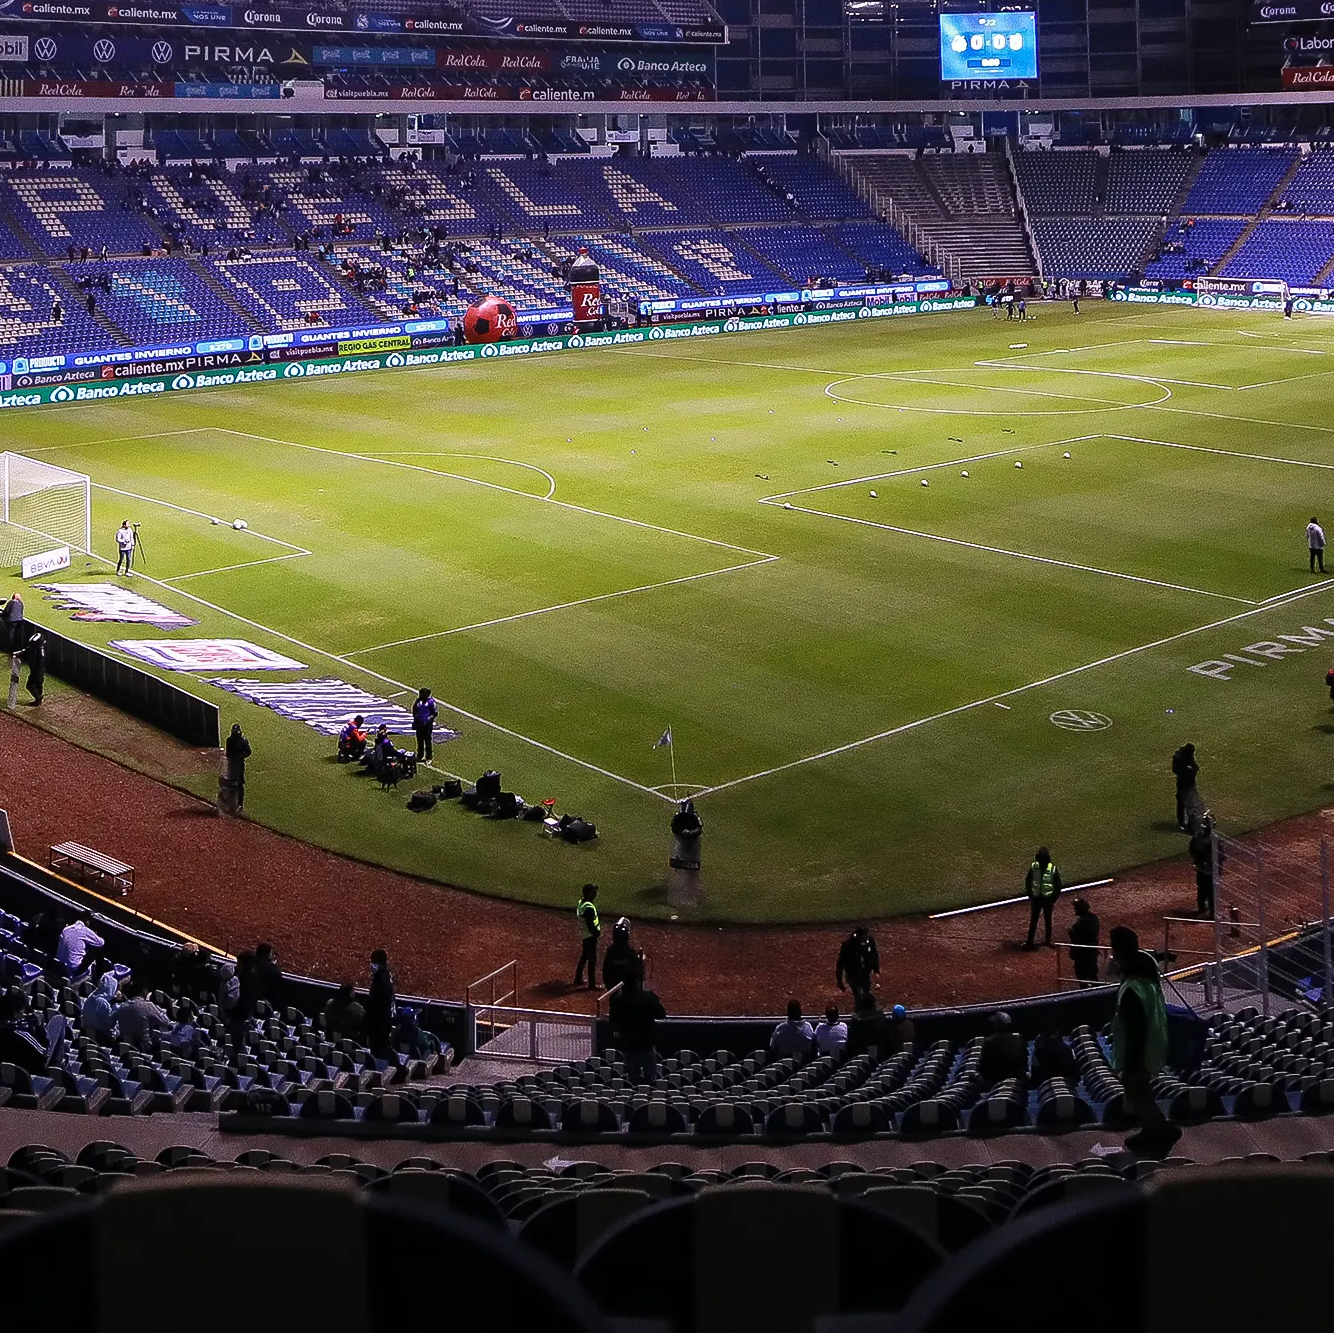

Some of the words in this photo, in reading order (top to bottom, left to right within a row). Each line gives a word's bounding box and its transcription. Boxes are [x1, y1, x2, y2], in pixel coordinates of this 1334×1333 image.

[33, 3, 90, 15] caliente.mx
[119, 8, 177, 20] caliente.mx
[1261, 6, 1296, 18] Corona
[245, 10, 281, 24] Corona
[307, 12, 343, 26] Corona
[414, 20, 463, 30] caliente.mx
[525, 24, 567, 34] caliente.mx
[588, 26, 632, 36] caliente.mx
[185, 45, 274, 63] PIRMA
[638, 61, 669, 71] Banco
[671, 61, 707, 71] Azteca
[952, 81, 1009, 90] PIRMA
[933, 302, 954, 311] Banco
[955, 299, 975, 308] Azteca
[1128, 294, 1157, 303] Banco
[1158, 294, 1192, 304] Azteca
[808, 314, 830, 324] Banco
[832, 311, 855, 321] Azteca
[872, 307, 891, 317] Banco
[893, 305, 916, 314] Azteca
[495, 312, 516, 328] Red
[739, 321, 763, 331] Banco
[764, 317, 789, 328] Azteca
[301, 331, 350, 342] GUANTES
[353, 326, 400, 337] INVIERNO
[585, 334, 613, 346] Banco
[614, 331, 644, 344] Azteca
[665, 327, 690, 339] Banco
[692, 325, 719, 335] Azteca
[339, 343, 361, 352] REGIO
[364, 341, 377, 350] GAS
[379, 338, 410, 348] CENTRAL
[499, 344, 529, 355] Banco
[531, 341, 562, 351] Azteca
[74, 351, 132, 366] GUANTES
[135, 346, 191, 359] INVIERNO
[186, 353, 241, 368] PIRMA
[406, 354, 439, 366] Banco
[441, 350, 474, 362] Azteca
[115, 360, 184, 377] caliente.mx
[306, 363, 346, 376] Banco
[348, 359, 380, 371] Azteca
[35, 373, 62, 384] Banco
[64, 370, 94, 381] Azteca
[196, 371, 235, 387] Banco
[237, 367, 276, 381] Azteca
[77, 385, 118, 401] Banco
[120, 380, 164, 395] Azteca
[30, 559, 55, 573] BBVA
